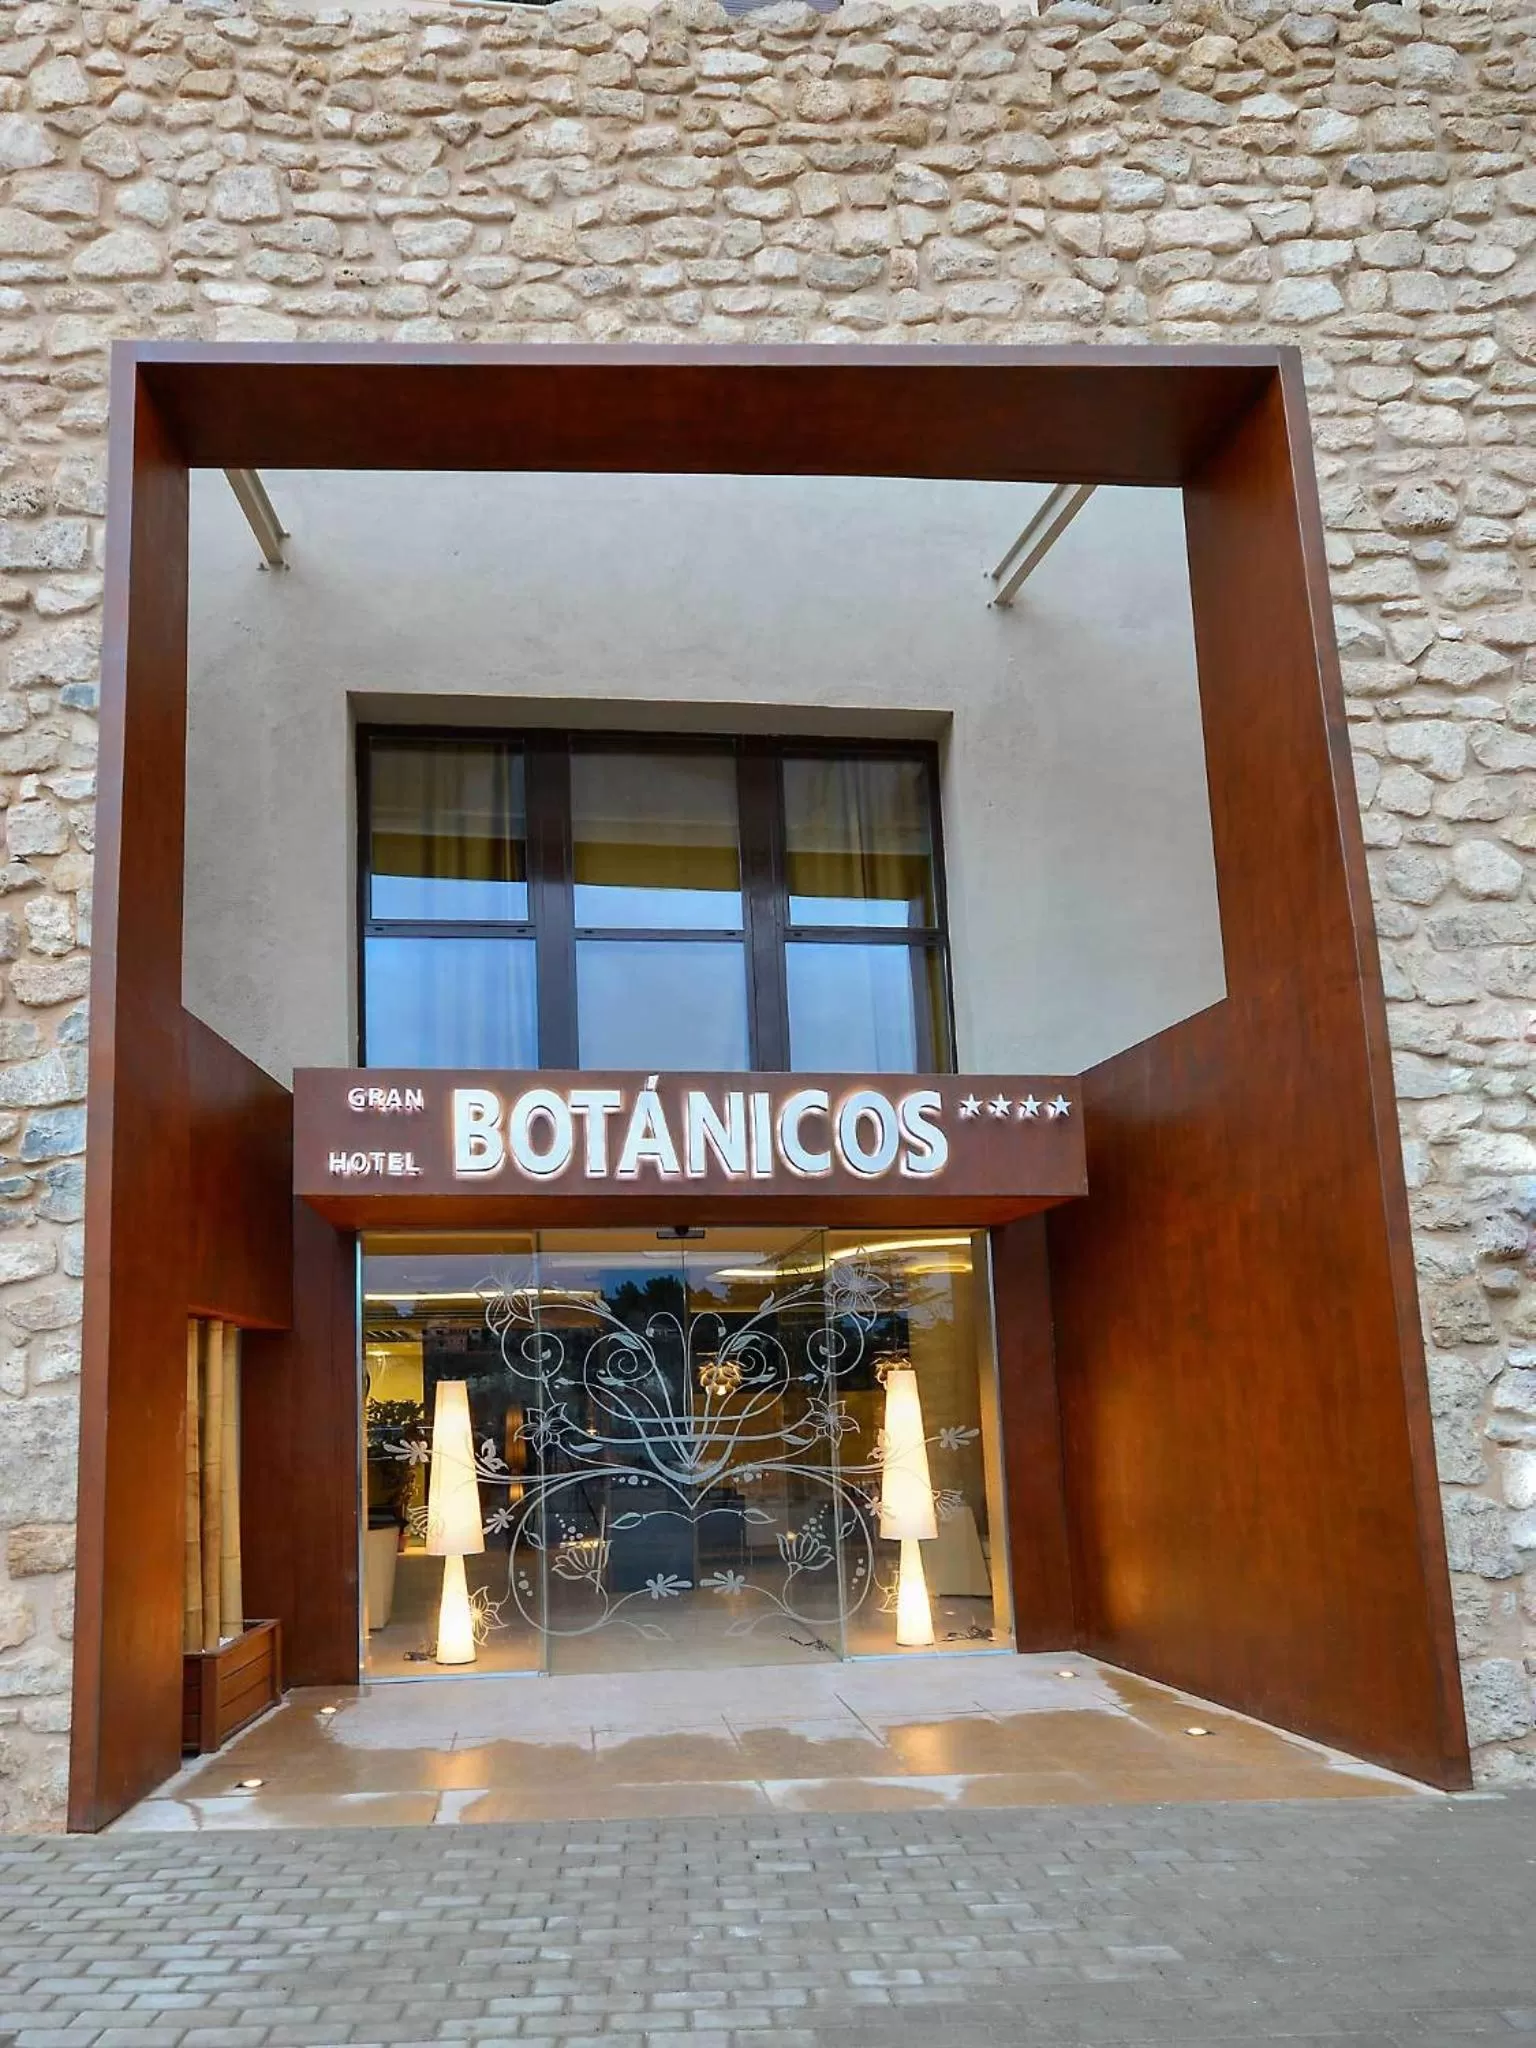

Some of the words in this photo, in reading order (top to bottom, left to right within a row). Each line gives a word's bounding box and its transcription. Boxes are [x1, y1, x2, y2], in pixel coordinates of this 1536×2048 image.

[347, 1087, 425, 1111] GRAN
[452, 1074, 950, 1179] BOTÁNICOS
[328, 1151, 422, 1176] HOTEL
